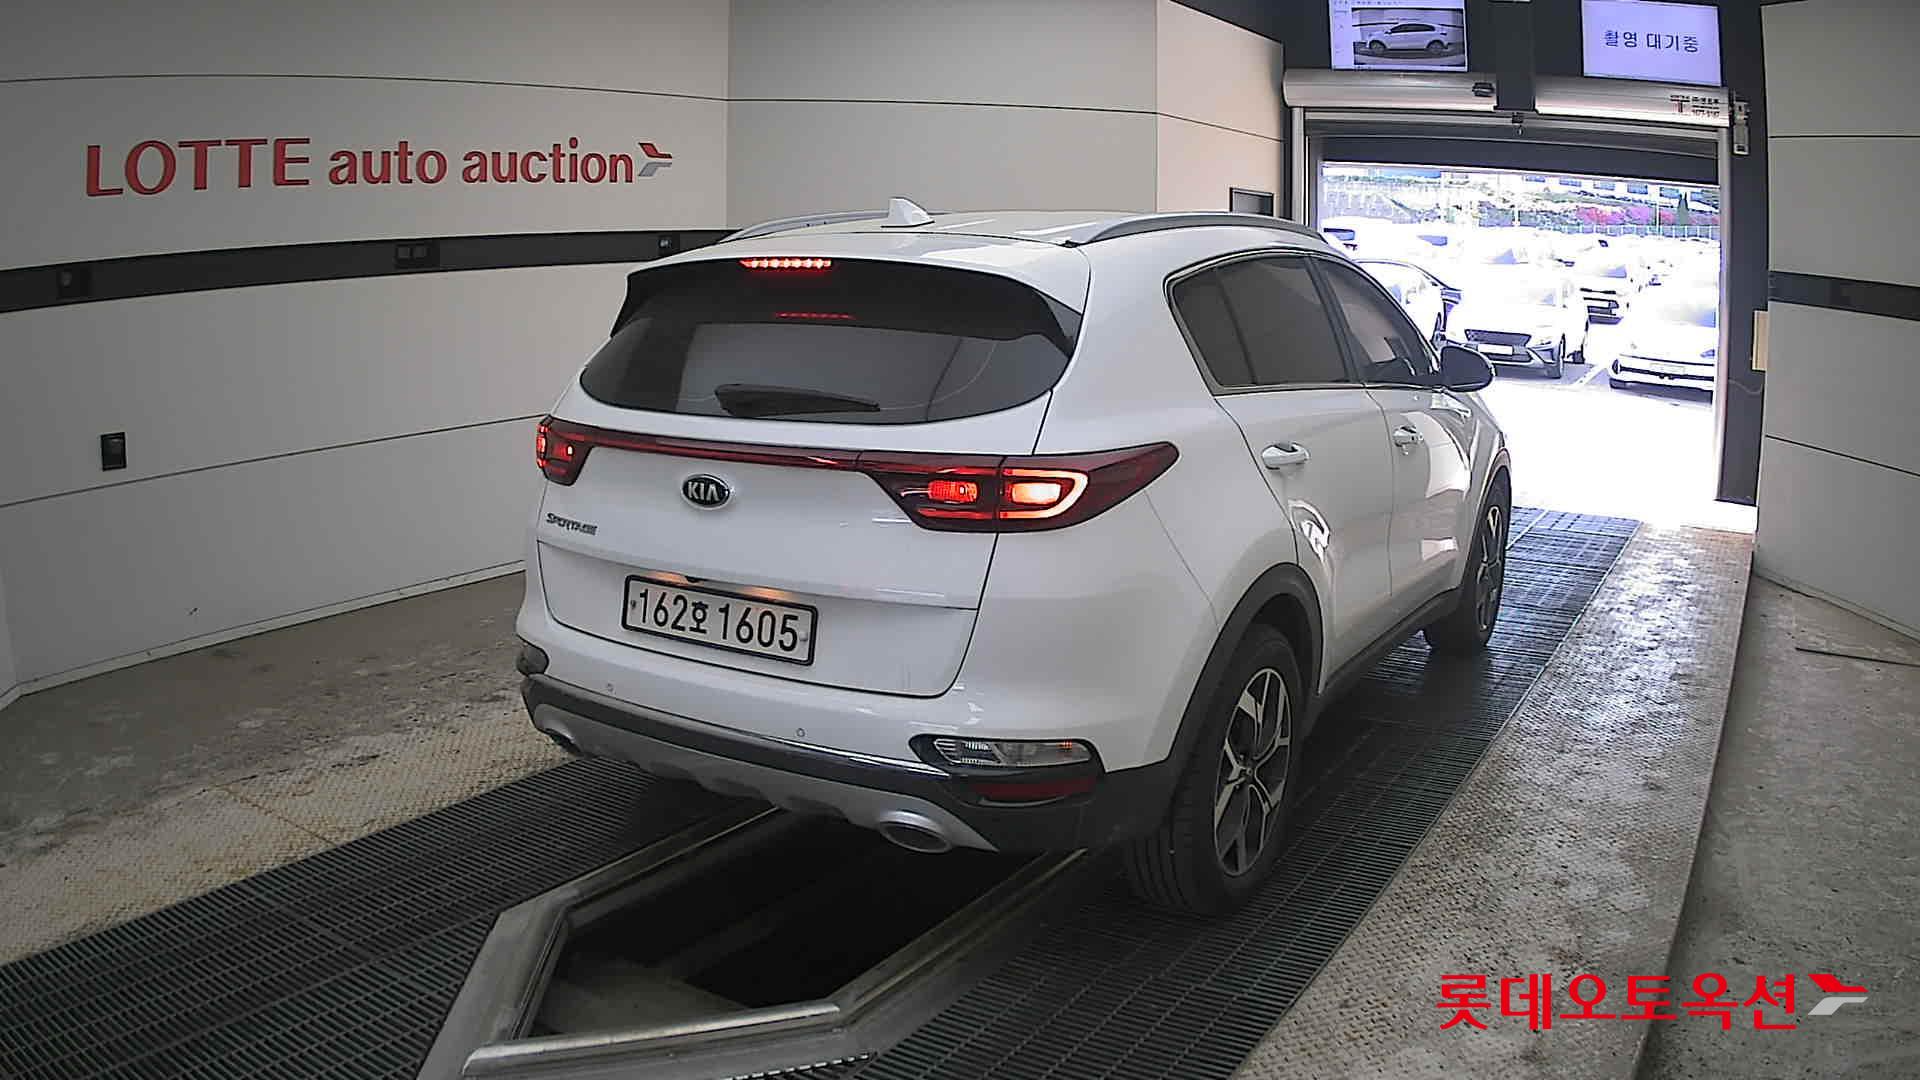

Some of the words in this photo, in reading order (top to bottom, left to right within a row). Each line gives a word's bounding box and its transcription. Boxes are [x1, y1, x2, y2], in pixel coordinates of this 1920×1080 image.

[1647, 33, 1698, 52] 대기중
[86, 138, 310, 197] LOTTE
[328, 141, 447, 185] auto
[462, 137, 634, 184] auction
[688, 481, 719, 501] KIA
[639, 588, 709, 634] 162호
[718, 603, 799, 651] 1605
